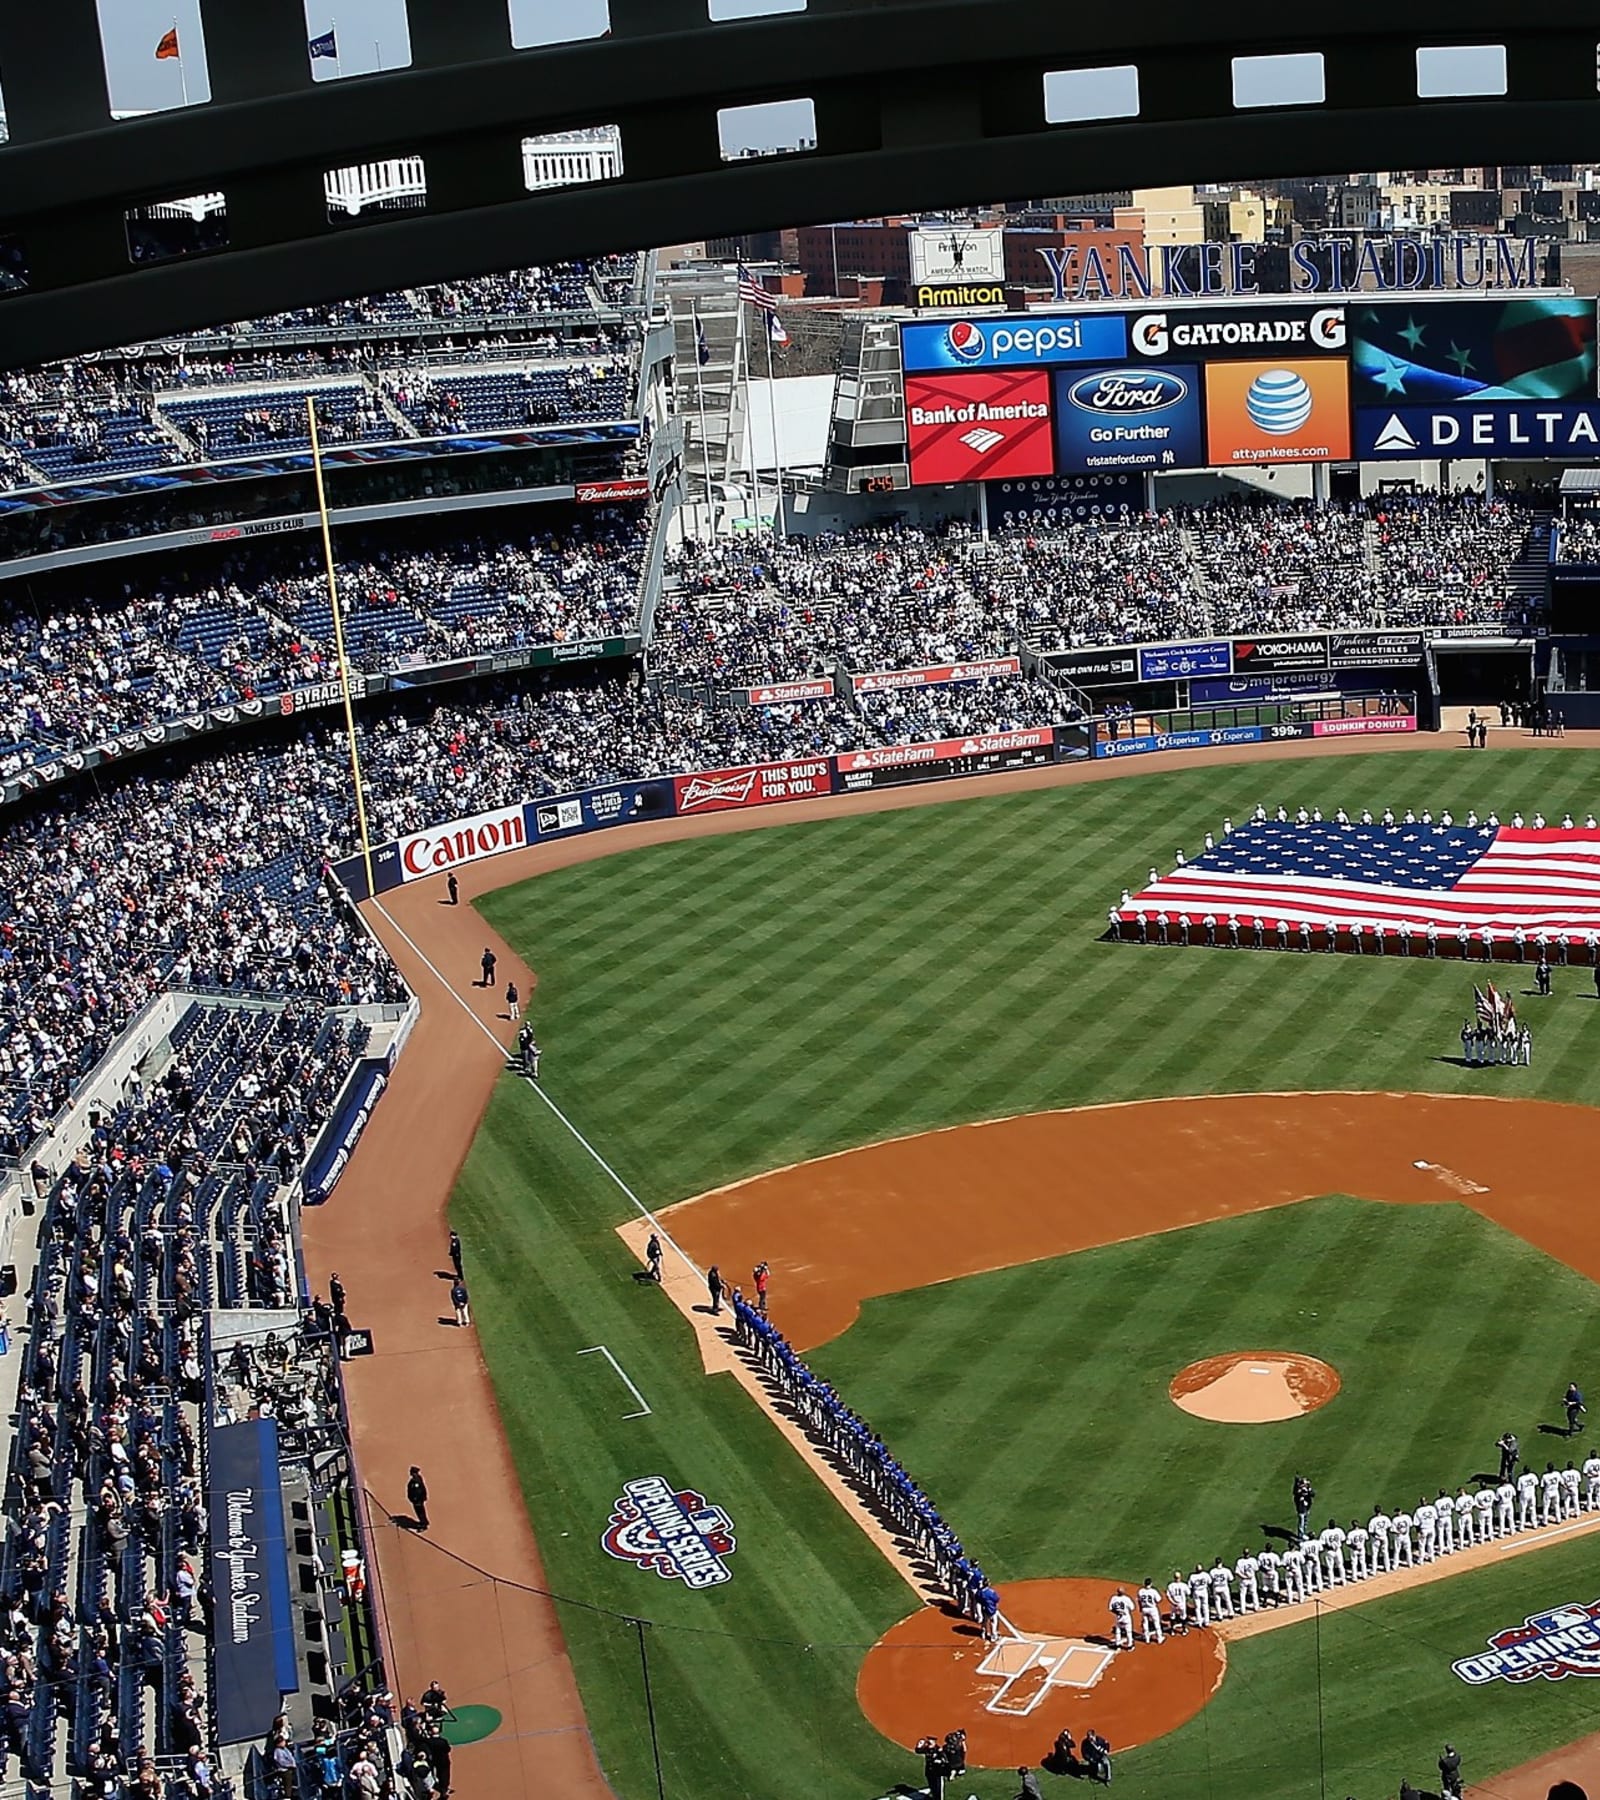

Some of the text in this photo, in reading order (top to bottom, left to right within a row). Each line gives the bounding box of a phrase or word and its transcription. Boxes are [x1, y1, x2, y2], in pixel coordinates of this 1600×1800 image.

[1035, 235, 1540, 301] YANKEE STADIUM
[918, 286, 1005, 306] Armitron
[992, 320, 1082, 359] pepsi
[1173, 321, 1306, 347] GATORADE
[1092, 376, 1163, 408] Ford
[912, 400, 1048, 425] Bank of America
[1090, 424, 1170, 442] Go Further
[1431, 412, 1599, 445] DELTA
[1086, 453, 1156, 466] tristateford.com
[1232, 446, 1329, 460] att.yankees.com
[577, 485, 648, 502] Budweiser
[244, 521, 281, 535] YANKEES
[282, 518, 304, 531] CLUB
[1255, 641, 1326, 656] YOKOHAMA
[1332, 635, 1370, 650] Yankees
[1343, 646, 1408, 655] COLLECTIBLES
[1249, 671, 1337, 690] majorenergy
[1328, 719, 1407, 732] DUNKIN' DONUTS
[980, 733, 1041, 751] StateFarm
[1117, 741, 1147, 753] Experian
[1167, 734, 1200, 746] Experian
[871, 748, 935, 766] StateFarm
[760, 762, 827, 783] THIS BUD'S
[681, 782, 754, 800] Budweiser
[762, 780, 816, 798] FOR YOU.
[561, 807, 578, 816] NEW
[404, 815, 523, 875] Canon
[627, 1477, 727, 1587] OPENING SERIES
[215, 1487, 261, 1644] Welcome to Yankee Stadium
[1456, 1624, 1594, 1681] OPENING
